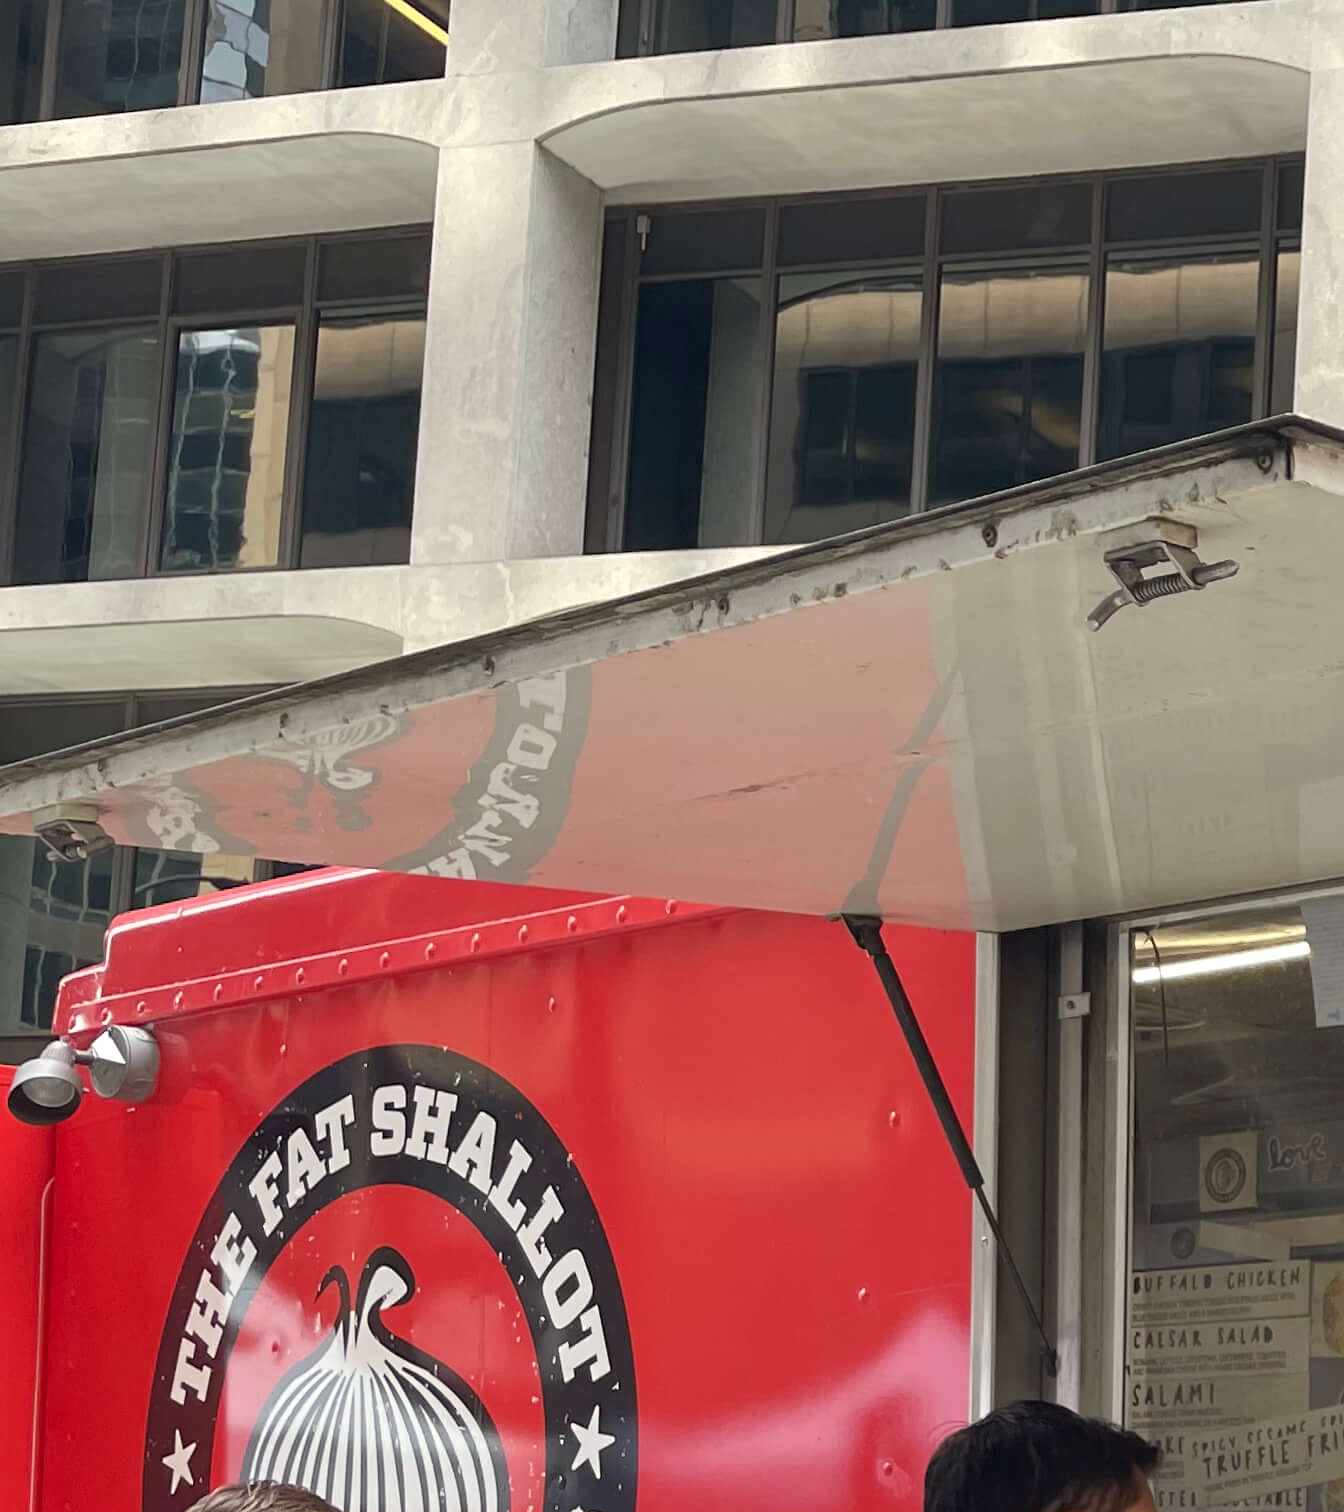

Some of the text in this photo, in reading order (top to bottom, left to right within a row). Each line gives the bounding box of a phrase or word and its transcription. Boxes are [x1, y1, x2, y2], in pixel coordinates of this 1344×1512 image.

[1268, 1135, 1328, 1172] love
[169, 1082, 613, 1408] THE FAT SHALLOT
[1227, 1267, 1300, 1289] CHICKEN
[1217, 1326, 1273, 1345] SALAD
[1132, 1384, 1215, 1408] SALAMI
[1203, 1440, 1290, 1479] TRUFFLE
